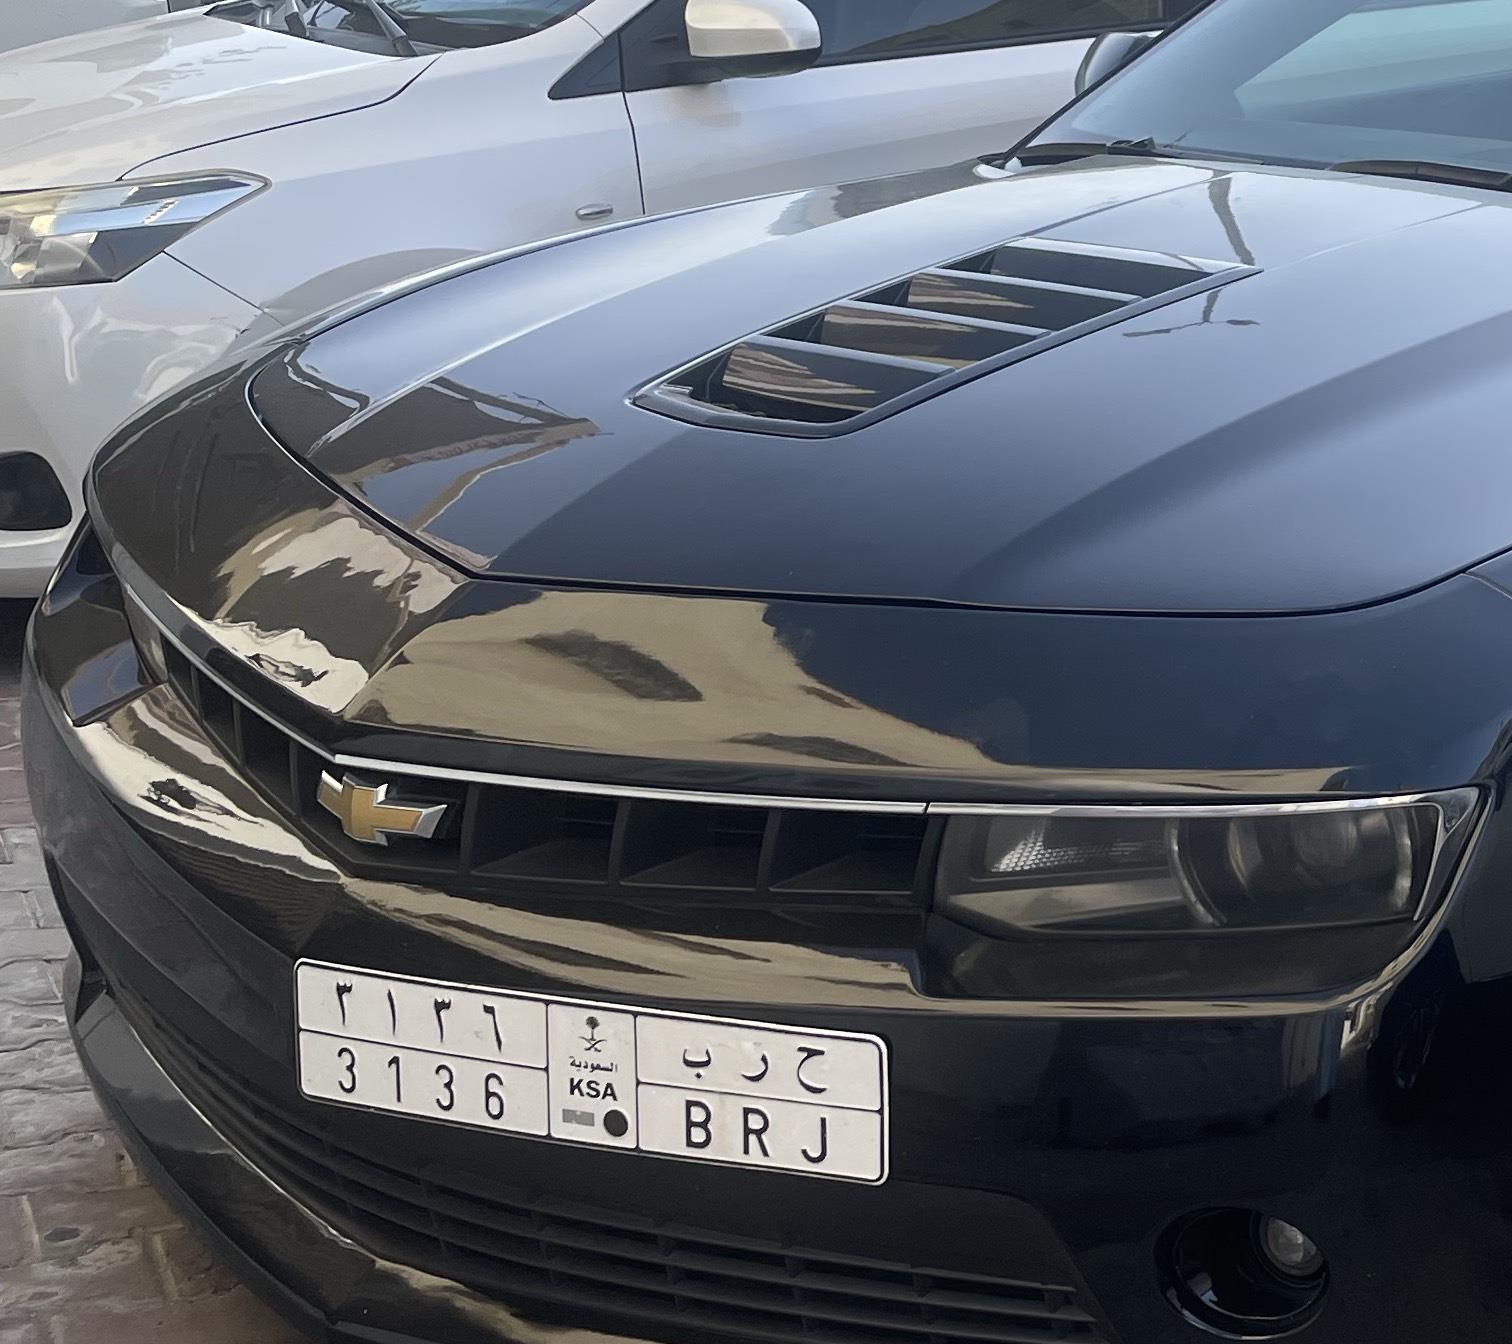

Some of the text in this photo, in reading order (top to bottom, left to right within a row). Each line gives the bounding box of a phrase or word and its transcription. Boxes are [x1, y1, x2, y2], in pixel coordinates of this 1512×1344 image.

[568, 1056, 618, 1073] السعودية
[337, 1047, 504, 1120] 3136
[569, 1077, 619, 1102] KSA
